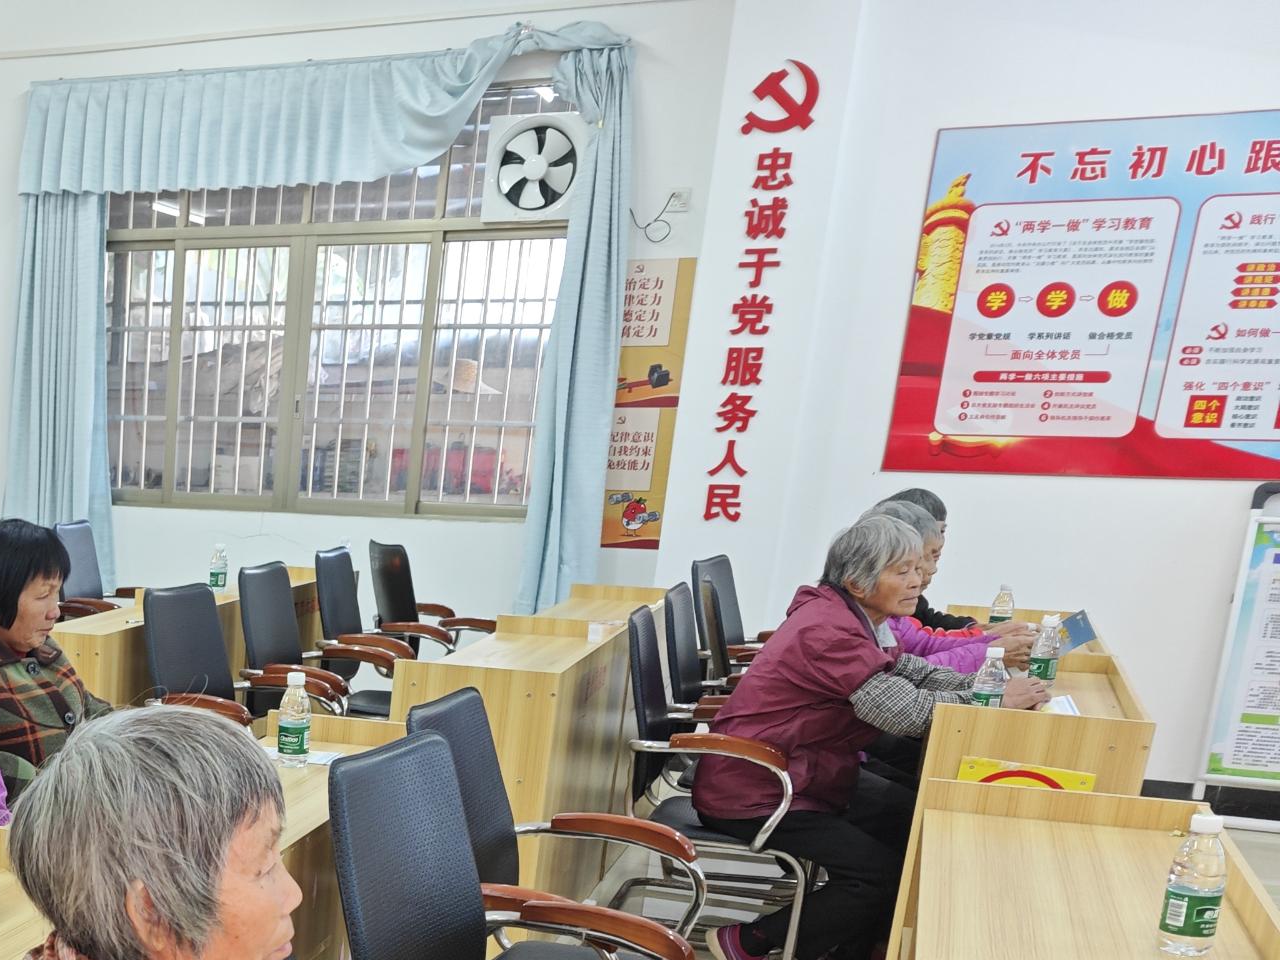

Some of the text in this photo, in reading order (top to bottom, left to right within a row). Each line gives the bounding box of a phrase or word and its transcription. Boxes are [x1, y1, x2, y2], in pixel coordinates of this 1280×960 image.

[1016, 139, 1280, 185] 不忘初心跟
[985, 291, 1007, 311] 学
[1045, 290, 1068, 310] 学
[1107, 288, 1130, 310] 做
[703, 147, 795, 524] 忠诚于党服务人民
[1010, 349, 1082, 361] 面向全体党员
[1193, 399, 1221, 411] 四个
